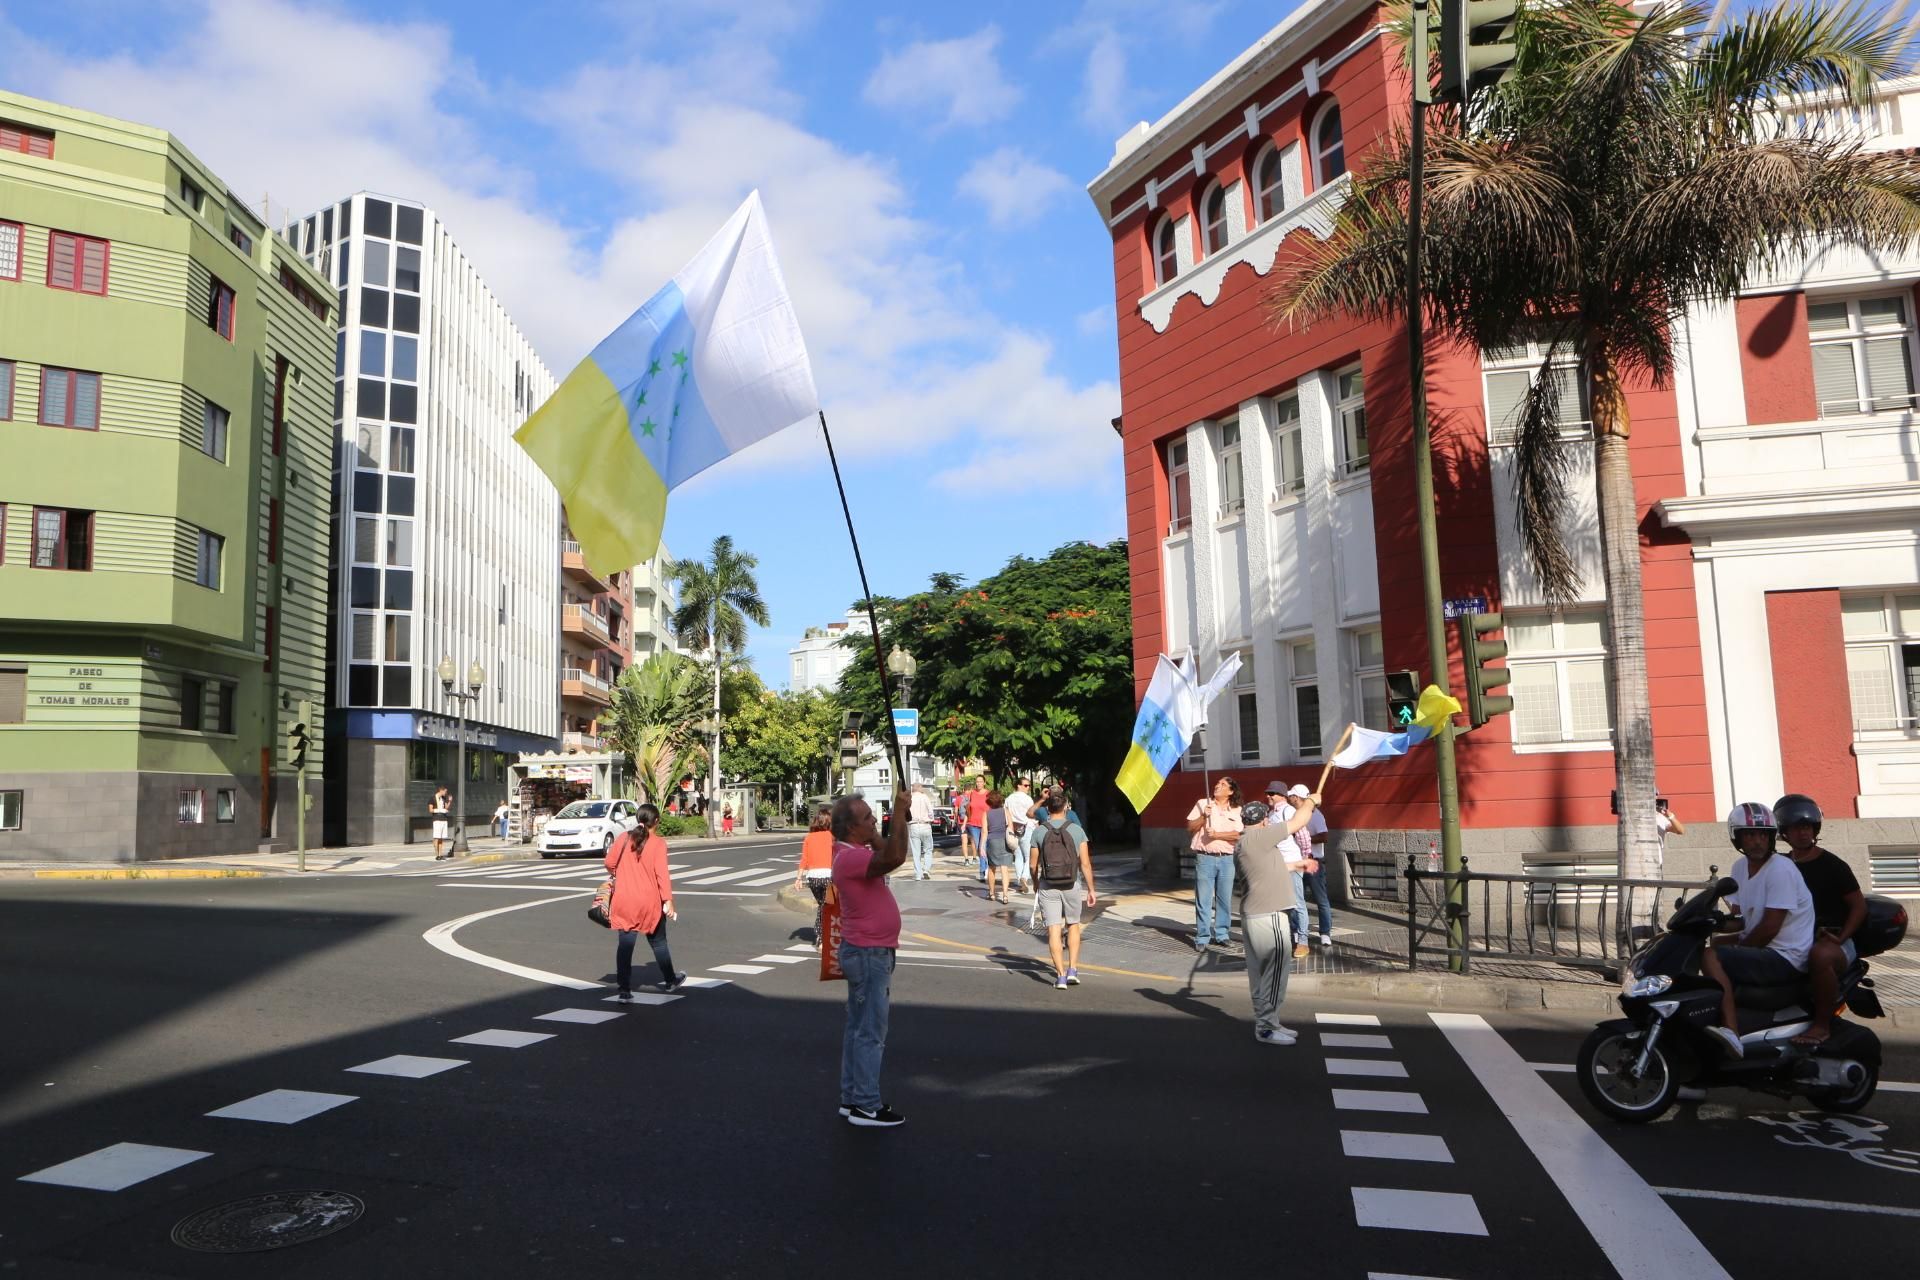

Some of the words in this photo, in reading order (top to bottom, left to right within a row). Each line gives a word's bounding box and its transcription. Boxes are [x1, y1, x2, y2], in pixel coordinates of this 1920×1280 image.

[69, 668, 103, 676] PASEO
[78, 682, 92, 690] DE
[40, 696, 75, 704] TOMAS
[82, 697, 130, 705] MORALES
